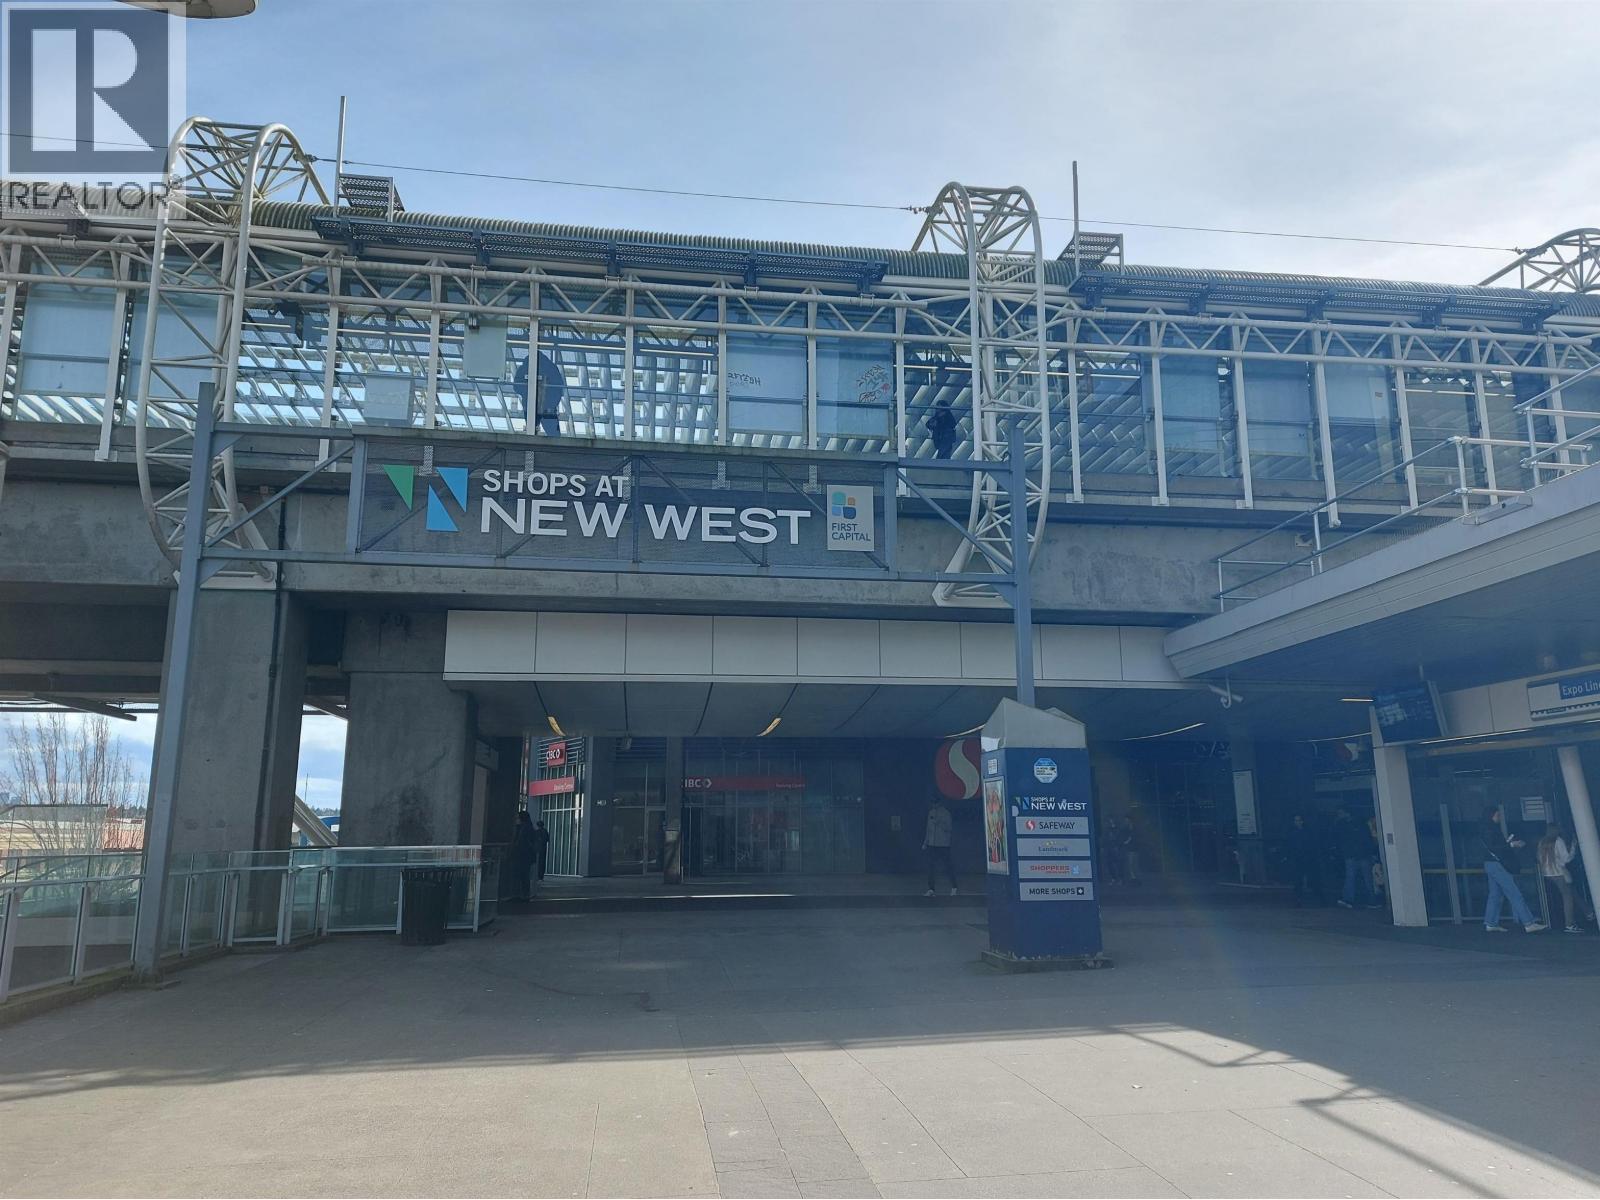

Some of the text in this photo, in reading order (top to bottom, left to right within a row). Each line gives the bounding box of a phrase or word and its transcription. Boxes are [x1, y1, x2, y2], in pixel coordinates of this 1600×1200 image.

[483, 469, 629, 498] SHOPS AT
[481, 496, 811, 545] NEW WEST
[832, 523, 857, 531] FIRST
[832, 532, 871, 541] CAPITAL
[1562, 685, 1583, 696] Expo
[681, 778, 701, 788] IBC
[1031, 802, 1087, 810] NEW WEST
[1039, 821, 1075, 829] SAFEWAY
